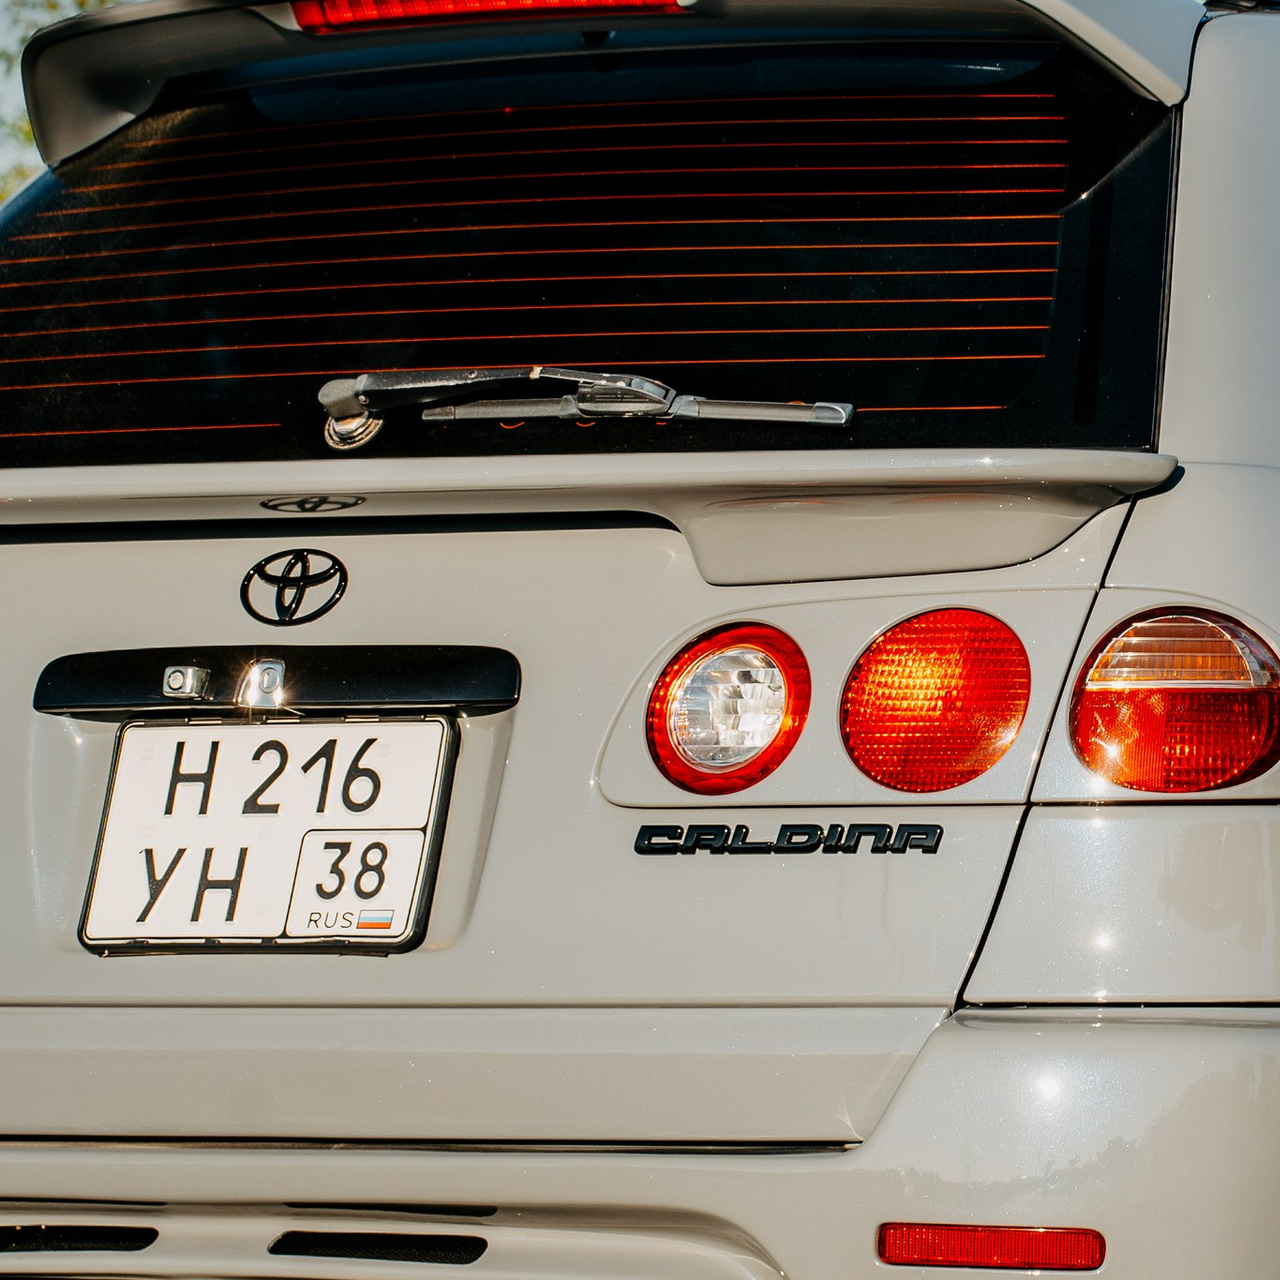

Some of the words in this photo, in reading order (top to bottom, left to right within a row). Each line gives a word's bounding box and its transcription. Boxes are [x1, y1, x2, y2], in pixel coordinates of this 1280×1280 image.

[633, 822, 944, 856] CALDINA
[136, 846, 249, 923] УН
[314, 840, 391, 901] 38
[307, 911, 354, 929] RUS
